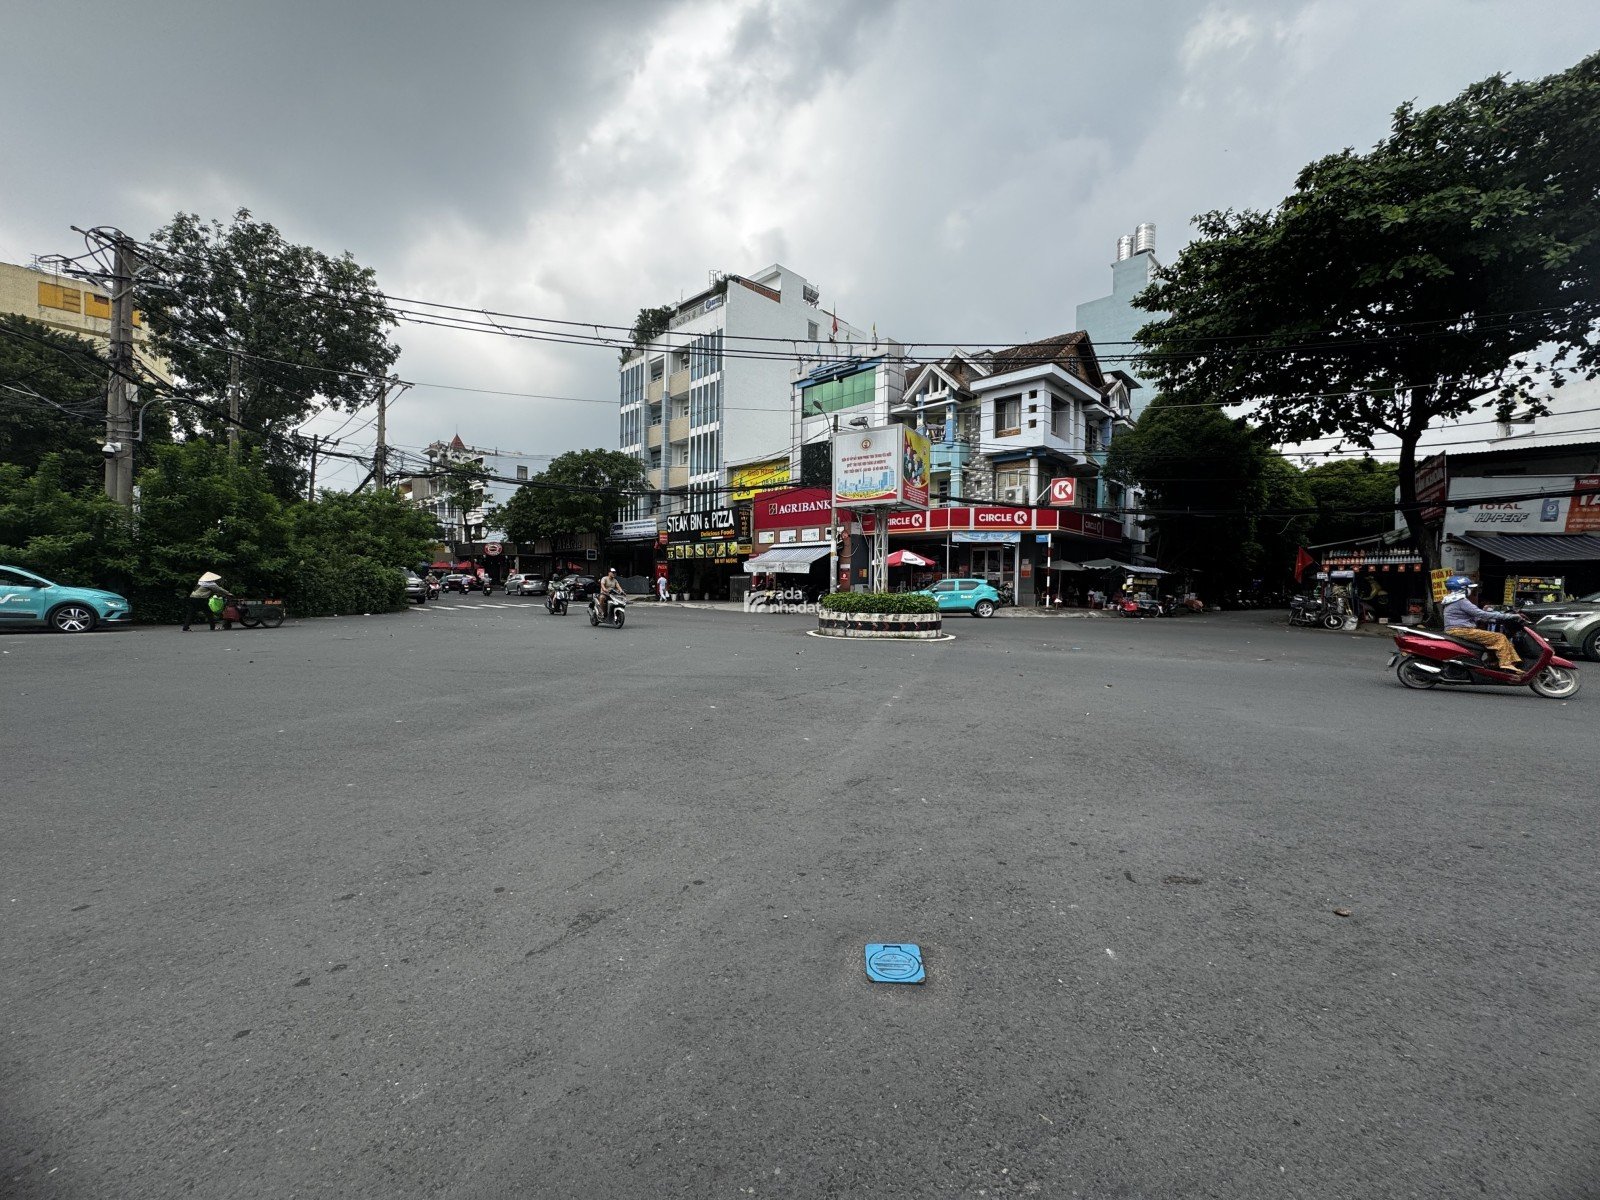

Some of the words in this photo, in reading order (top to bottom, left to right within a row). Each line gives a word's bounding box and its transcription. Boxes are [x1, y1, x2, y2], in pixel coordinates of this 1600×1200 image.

[1054, 480, 1072, 499] K
[778, 499, 832, 514] AGRIBANK
[667, 515, 689, 532] STEAK
[690, 513, 703, 531] BIN
[704, 517, 710, 529] &
[711, 510, 735, 528] PIZZA
[911, 513, 923, 527] K
[978, 512, 1012, 522] CIRCLE
[1013, 510, 1028, 525] K
[720, 528, 735, 536] Foods
